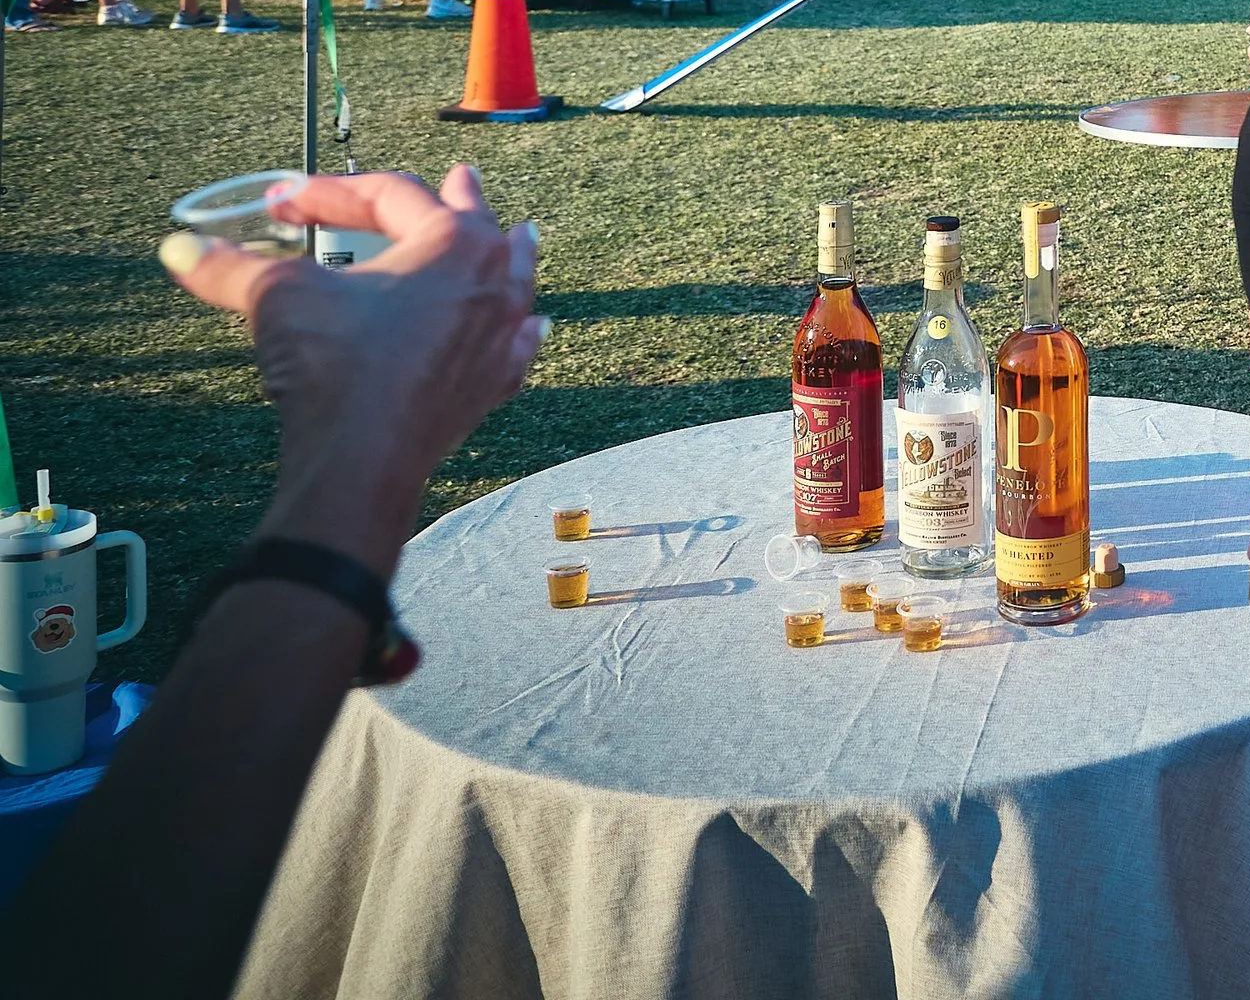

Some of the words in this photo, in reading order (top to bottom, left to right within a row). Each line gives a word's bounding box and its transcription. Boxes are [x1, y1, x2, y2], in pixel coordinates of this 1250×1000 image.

[935, 320, 947, 330] 16
[1001, 405, 1054, 473] P
[899, 437, 978, 490] YELLOWSTONE
[810, 486, 842, 494] WHISKEY
[1002, 489, 1051, 500] BOURBON
[936, 508, 969, 518] WHISKEY
[1001, 547, 1055, 561] WHEATED
